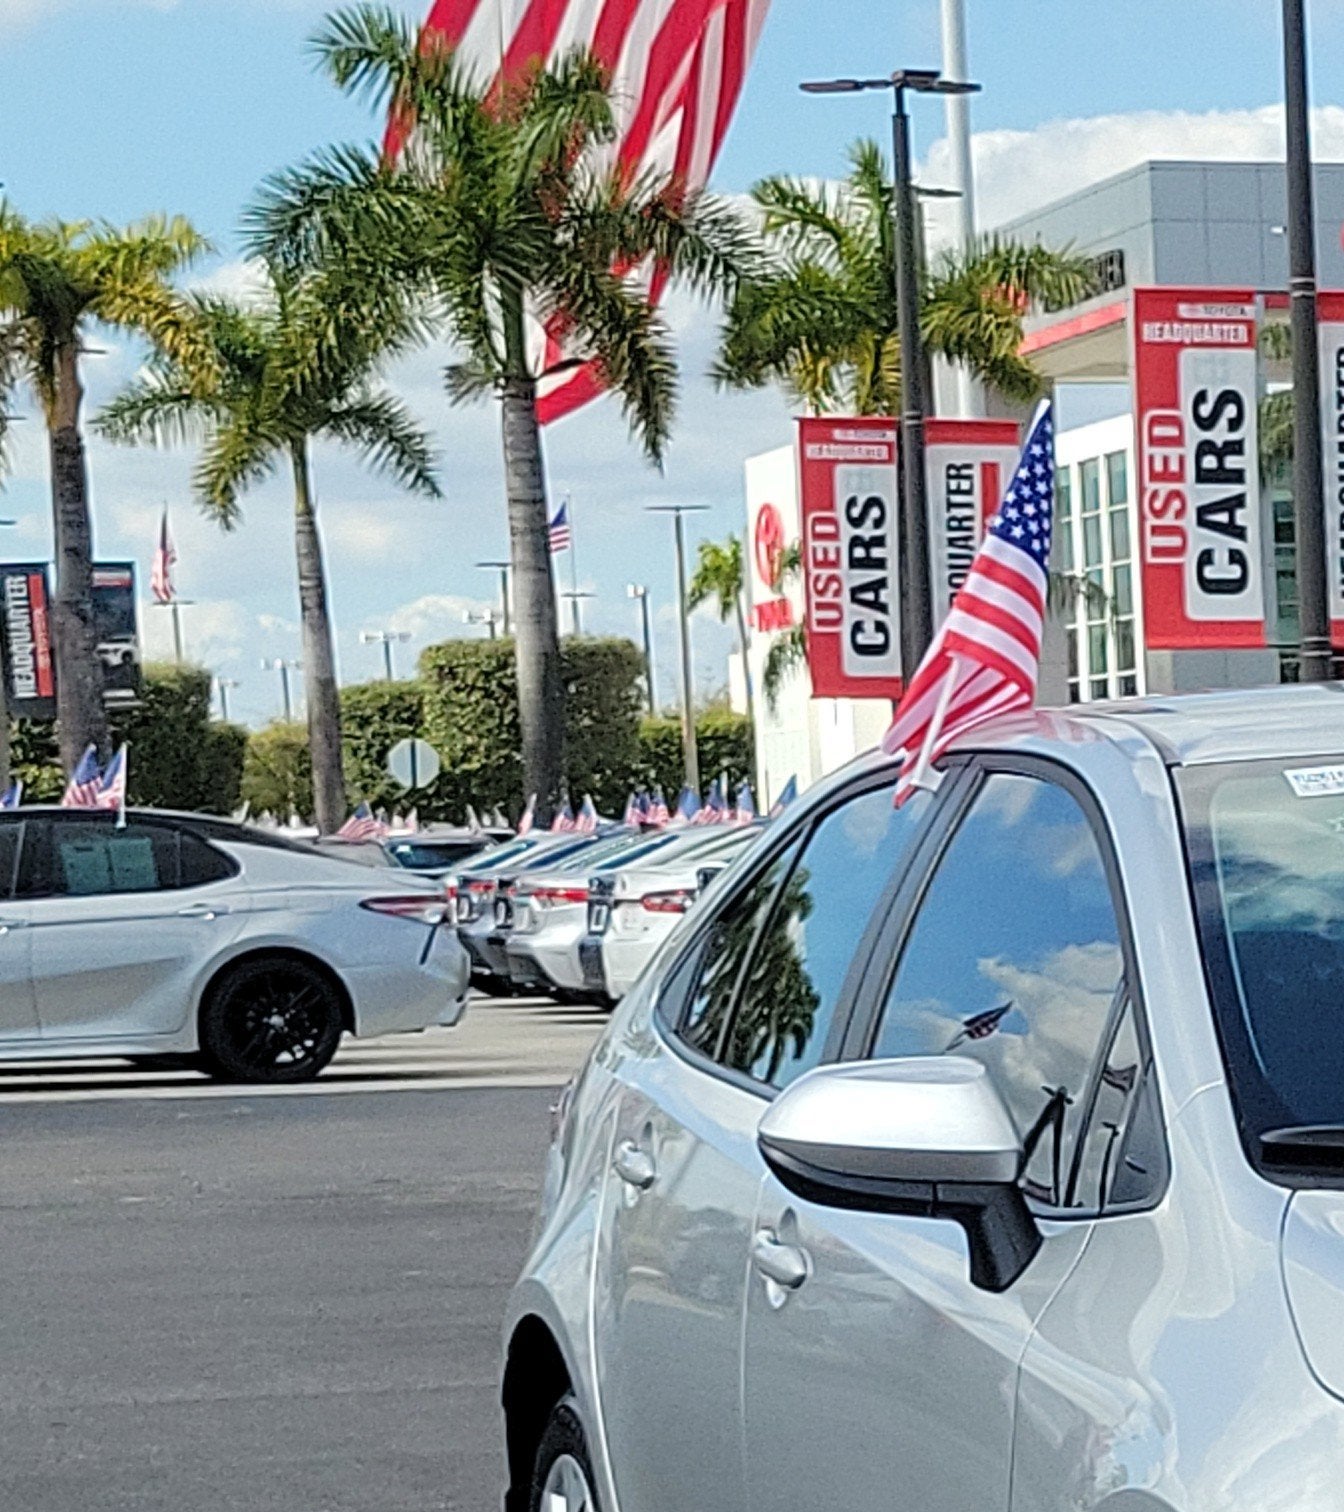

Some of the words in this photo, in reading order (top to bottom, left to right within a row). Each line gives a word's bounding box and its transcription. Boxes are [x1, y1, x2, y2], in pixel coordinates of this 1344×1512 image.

[946, 462, 976, 605] QUARTER
[1148, 413, 1189, 559] USED
[1191, 388, 1250, 596] CARS
[811, 515, 844, 629] USED
[845, 494, 891, 658] CARS
